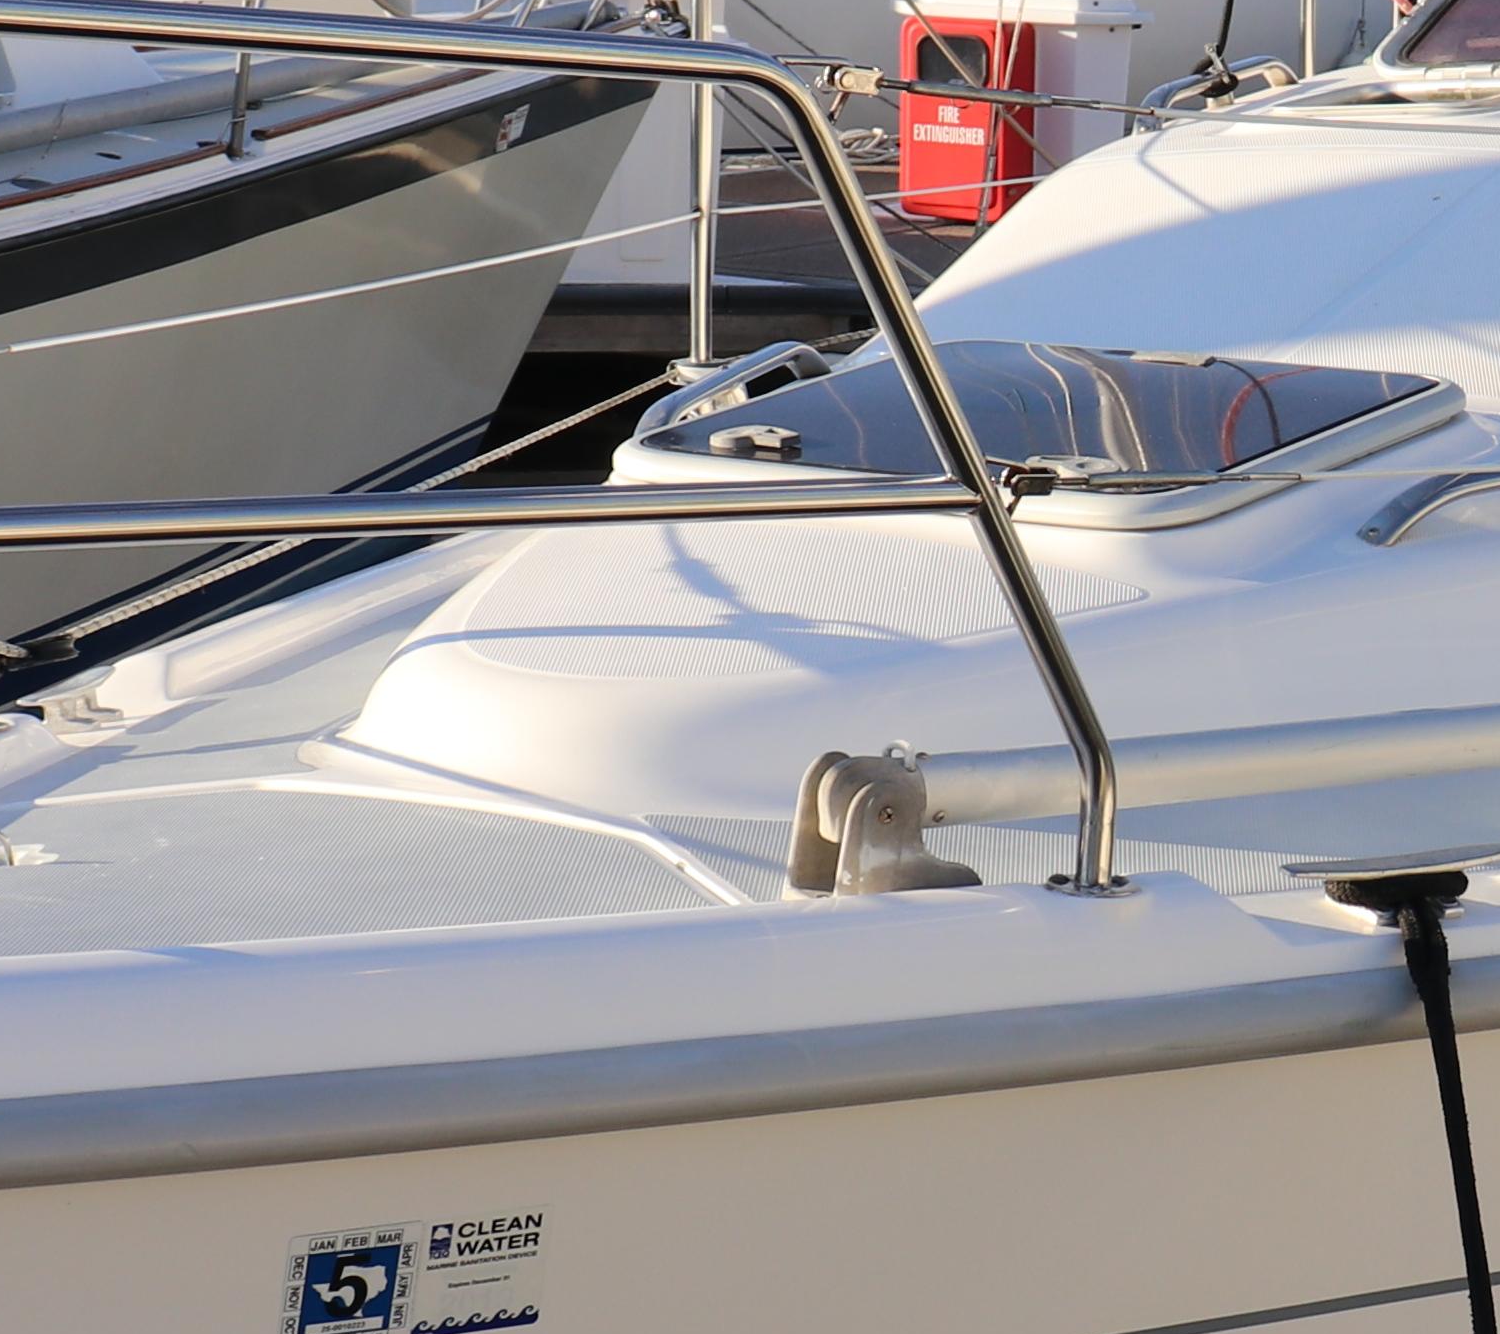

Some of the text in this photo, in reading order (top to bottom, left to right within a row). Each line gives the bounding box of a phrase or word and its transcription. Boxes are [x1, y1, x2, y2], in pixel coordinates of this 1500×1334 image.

[938, 106, 960, 124] FIRE
[913, 124, 985, 146] EXTINGUISHER
[457, 1213, 543, 1238] CLEAN
[310, 1232, 401, 1252] JAN FEB MAR
[456, 1233, 539, 1257] WATER
[402, 1244, 413, 1267] APR
[460, 1255, 506, 1267] SANITATION
[508, 1250, 538, 1260] DEVICE
[292, 1257, 305, 1280] DEC
[325, 1252, 372, 1318] 5
[396, 1275, 409, 1298] MAY
[288, 1287, 300, 1309] NOV
[393, 1306, 404, 1327] JUN
